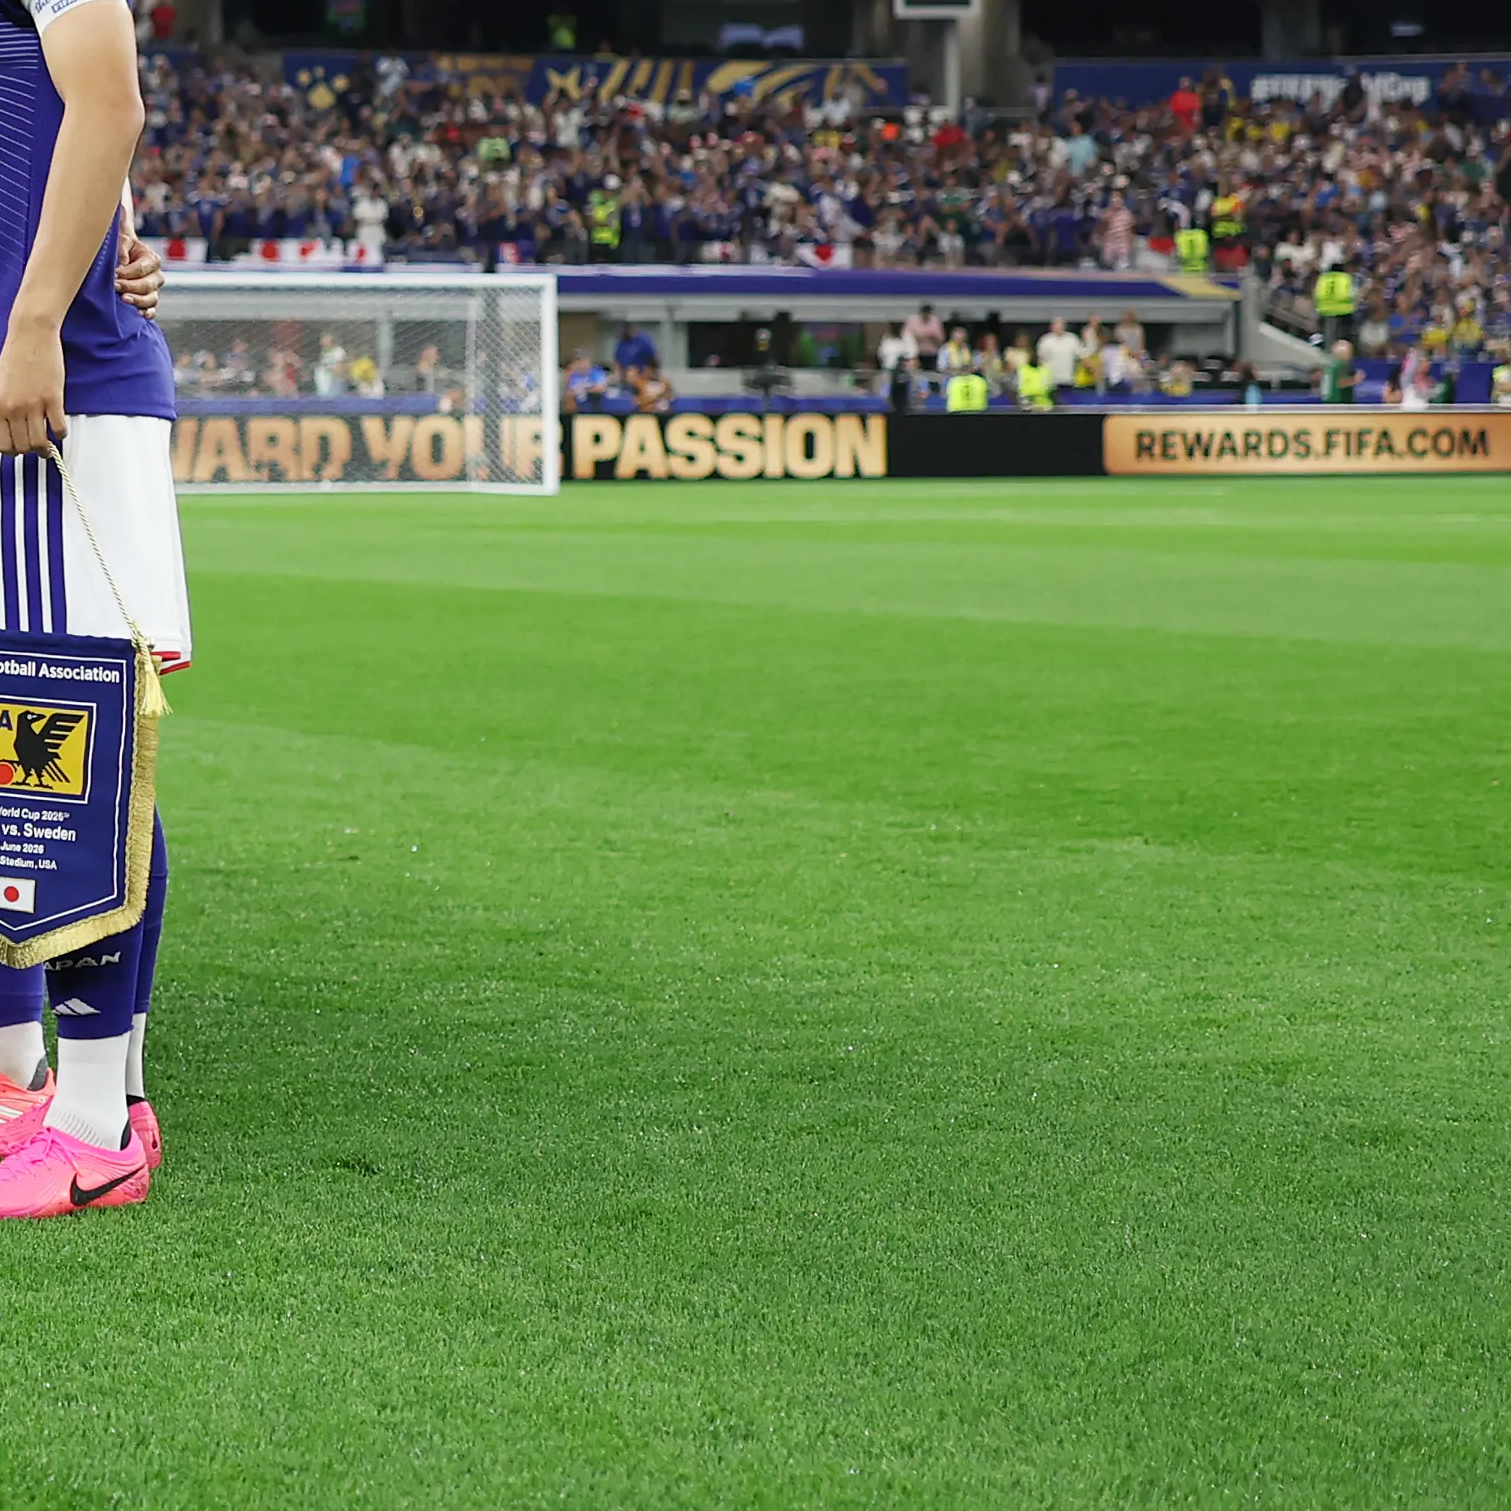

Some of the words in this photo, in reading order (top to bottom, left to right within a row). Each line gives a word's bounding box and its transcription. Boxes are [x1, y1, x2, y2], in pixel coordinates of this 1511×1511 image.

[571, 413, 888, 480] PASSION
[1135, 430, 1490, 461] REWARDS.FIFA.COM
[38, 662, 120, 683] Association
[21, 808, 40, 821] Cup
[1, 823, 21, 836] vs.
[23, 822, 76, 841] Sweden
[0, 841, 21, 852] June
[22, 843, 44, 854] 2026
[0, 856, 38, 869] Stadium,
[38, 859, 57, 870] USA
